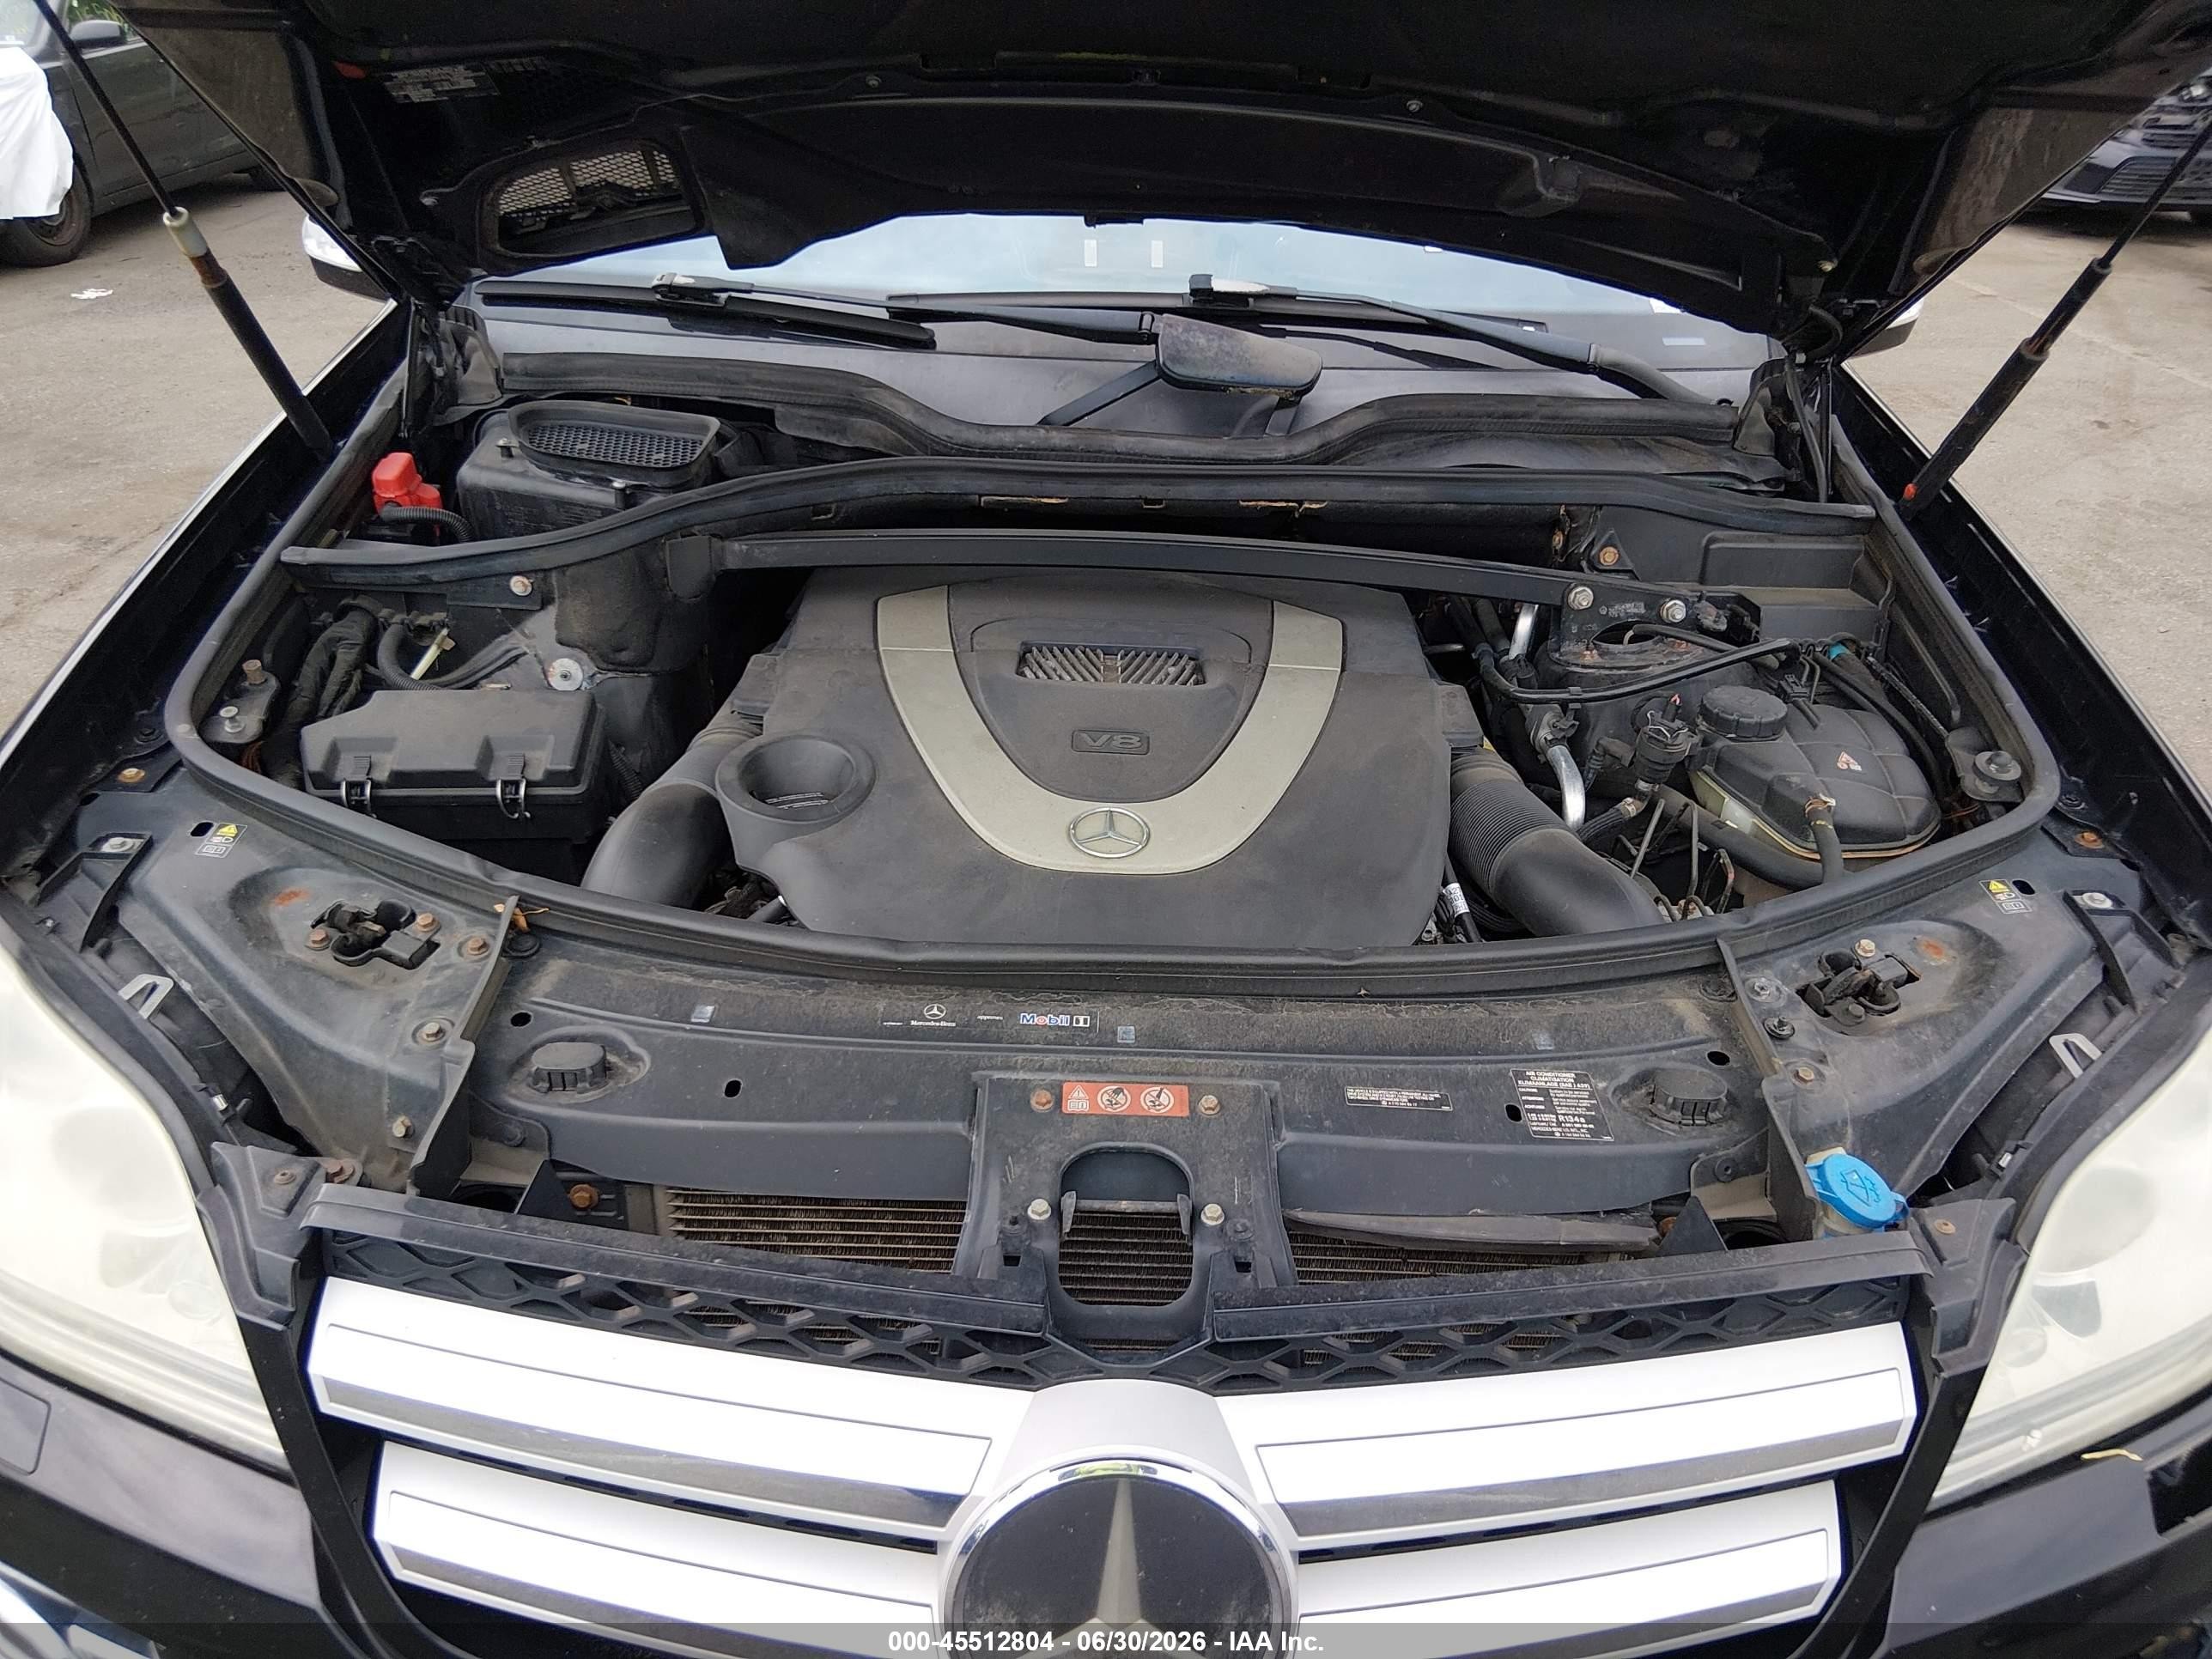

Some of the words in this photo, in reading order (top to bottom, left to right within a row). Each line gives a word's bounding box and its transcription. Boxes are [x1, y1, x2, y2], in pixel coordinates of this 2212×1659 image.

[1079, 732, 1142, 750] V8
[1020, 1012, 1071, 1026] Mobil
[1558, 1114, 1586, 1123] R134a
